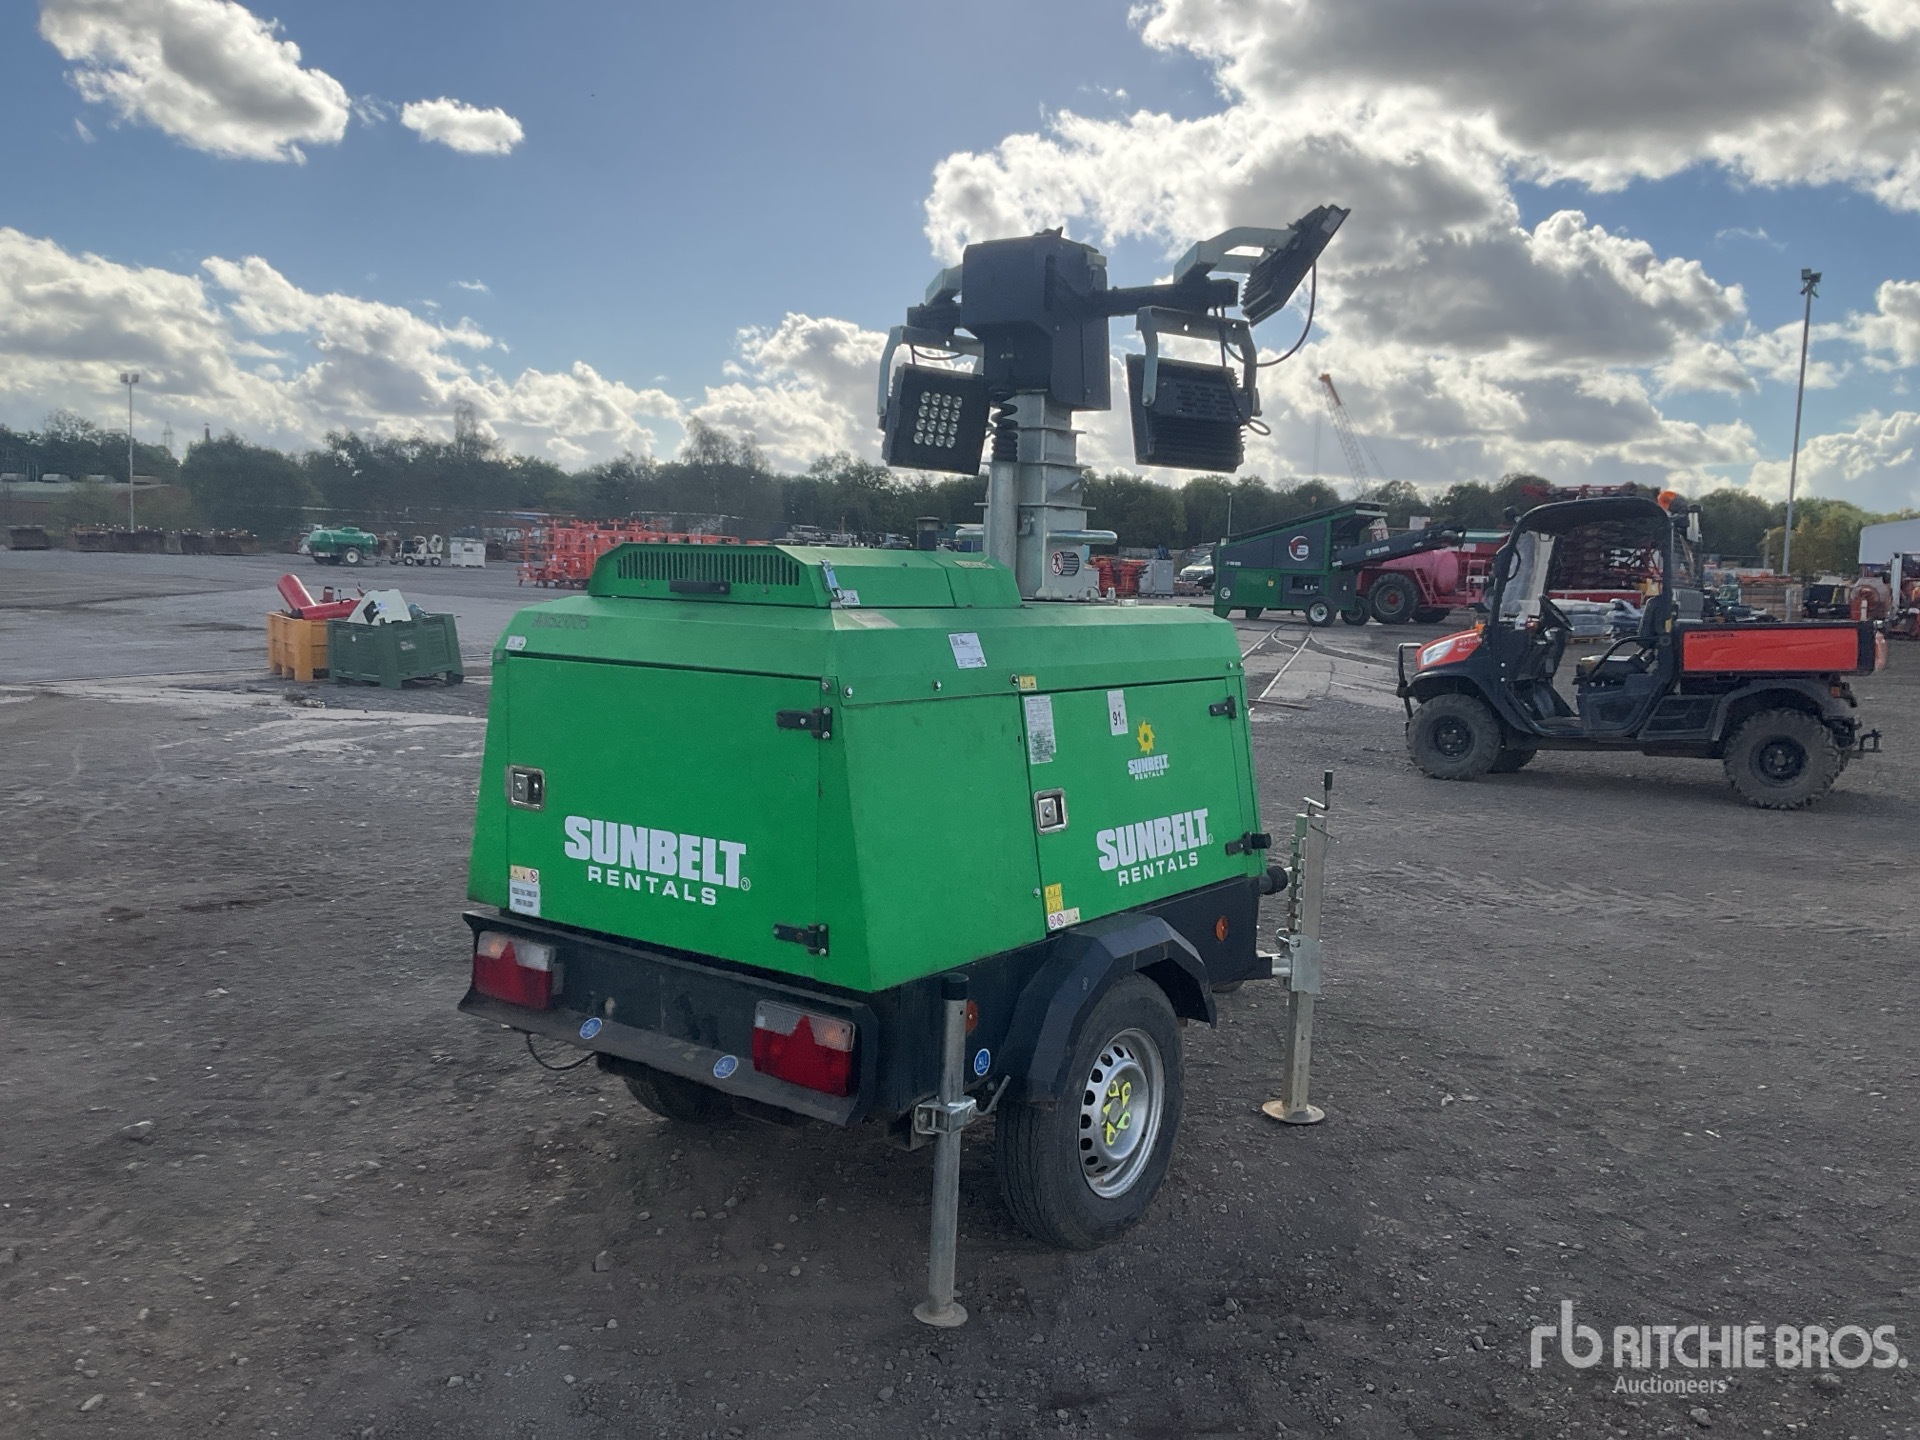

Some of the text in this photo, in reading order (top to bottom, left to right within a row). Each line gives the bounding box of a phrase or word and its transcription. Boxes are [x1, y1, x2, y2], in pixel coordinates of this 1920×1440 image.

[1128, 754, 1168, 774] SUNBELT
[564, 815, 747, 888] SUNBELT
[1096, 808, 1208, 871] SUNBELT
[588, 865, 716, 906] RENTALS
[1118, 851, 1198, 886] RENTALS
